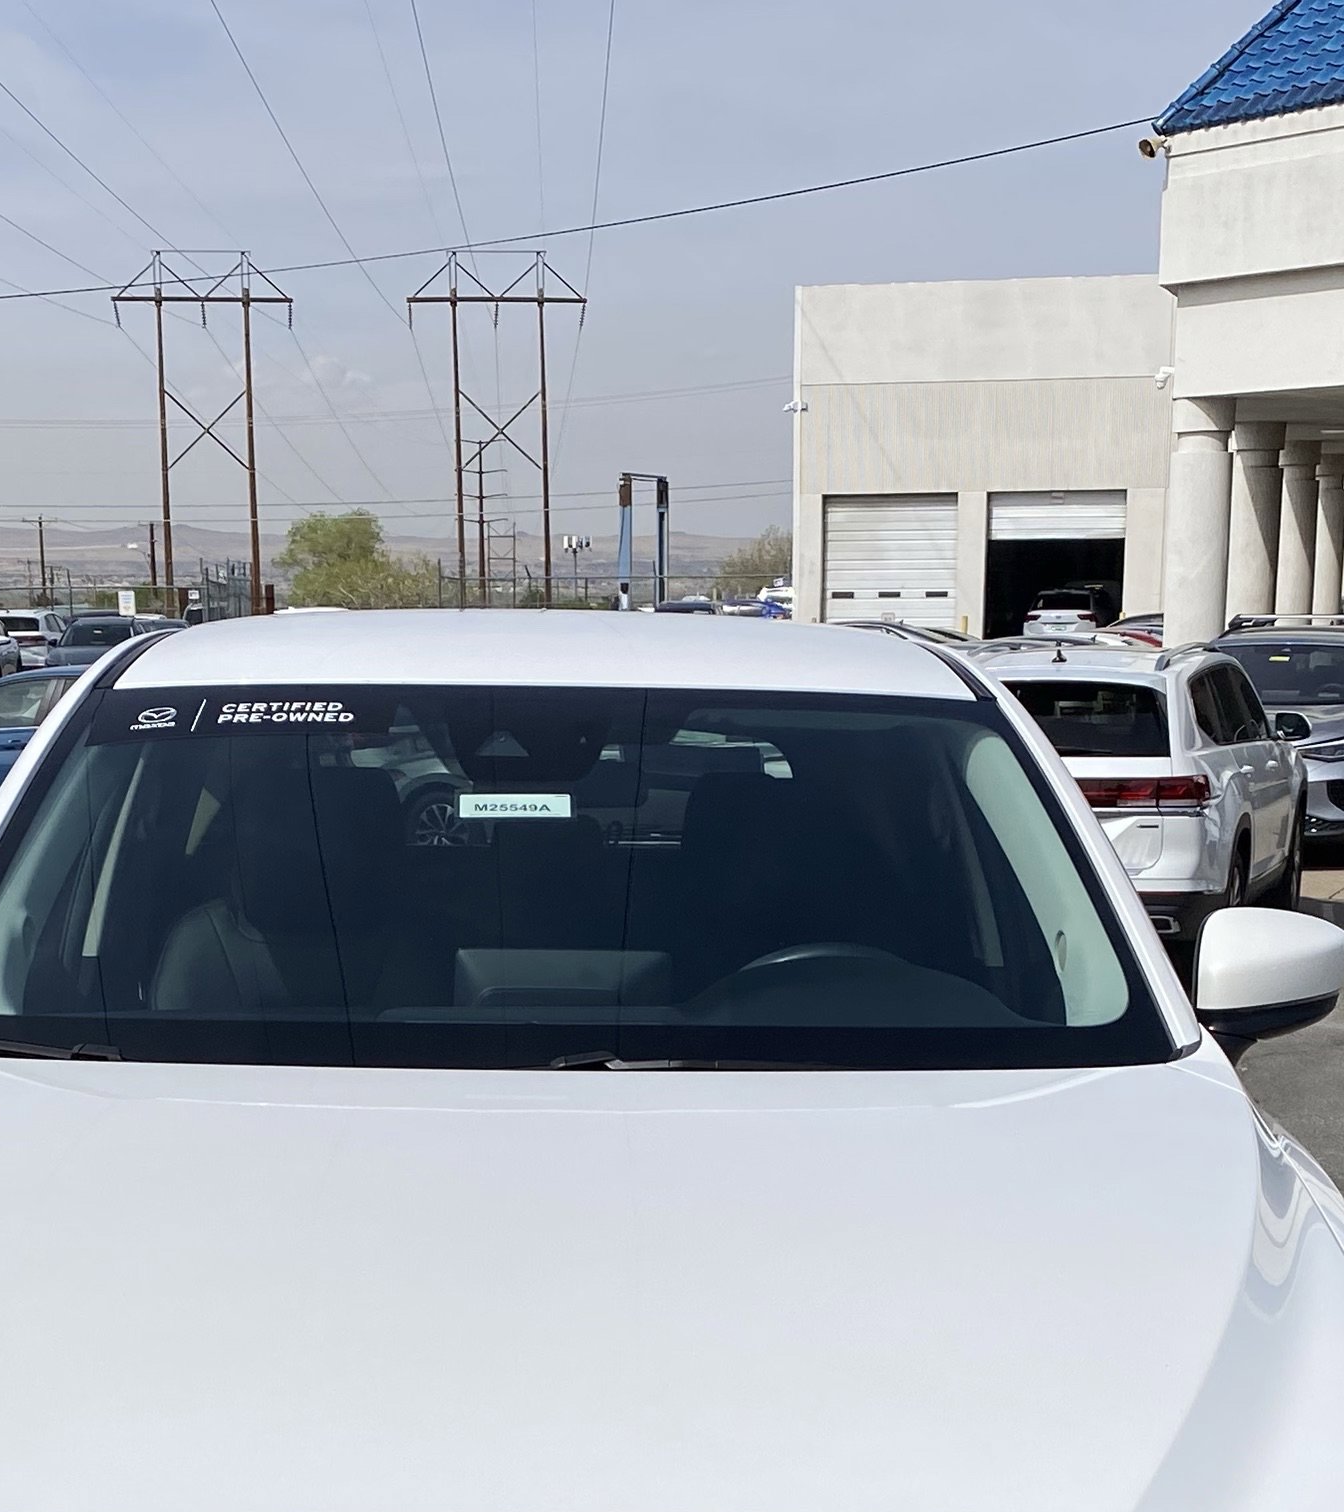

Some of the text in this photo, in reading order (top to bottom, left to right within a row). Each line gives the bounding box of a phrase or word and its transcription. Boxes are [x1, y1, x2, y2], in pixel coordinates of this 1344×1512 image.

[221, 701, 344, 713] CERTIFIED
[217, 711, 355, 724] PRE-OWNED
[473, 803, 552, 813] M25549A
